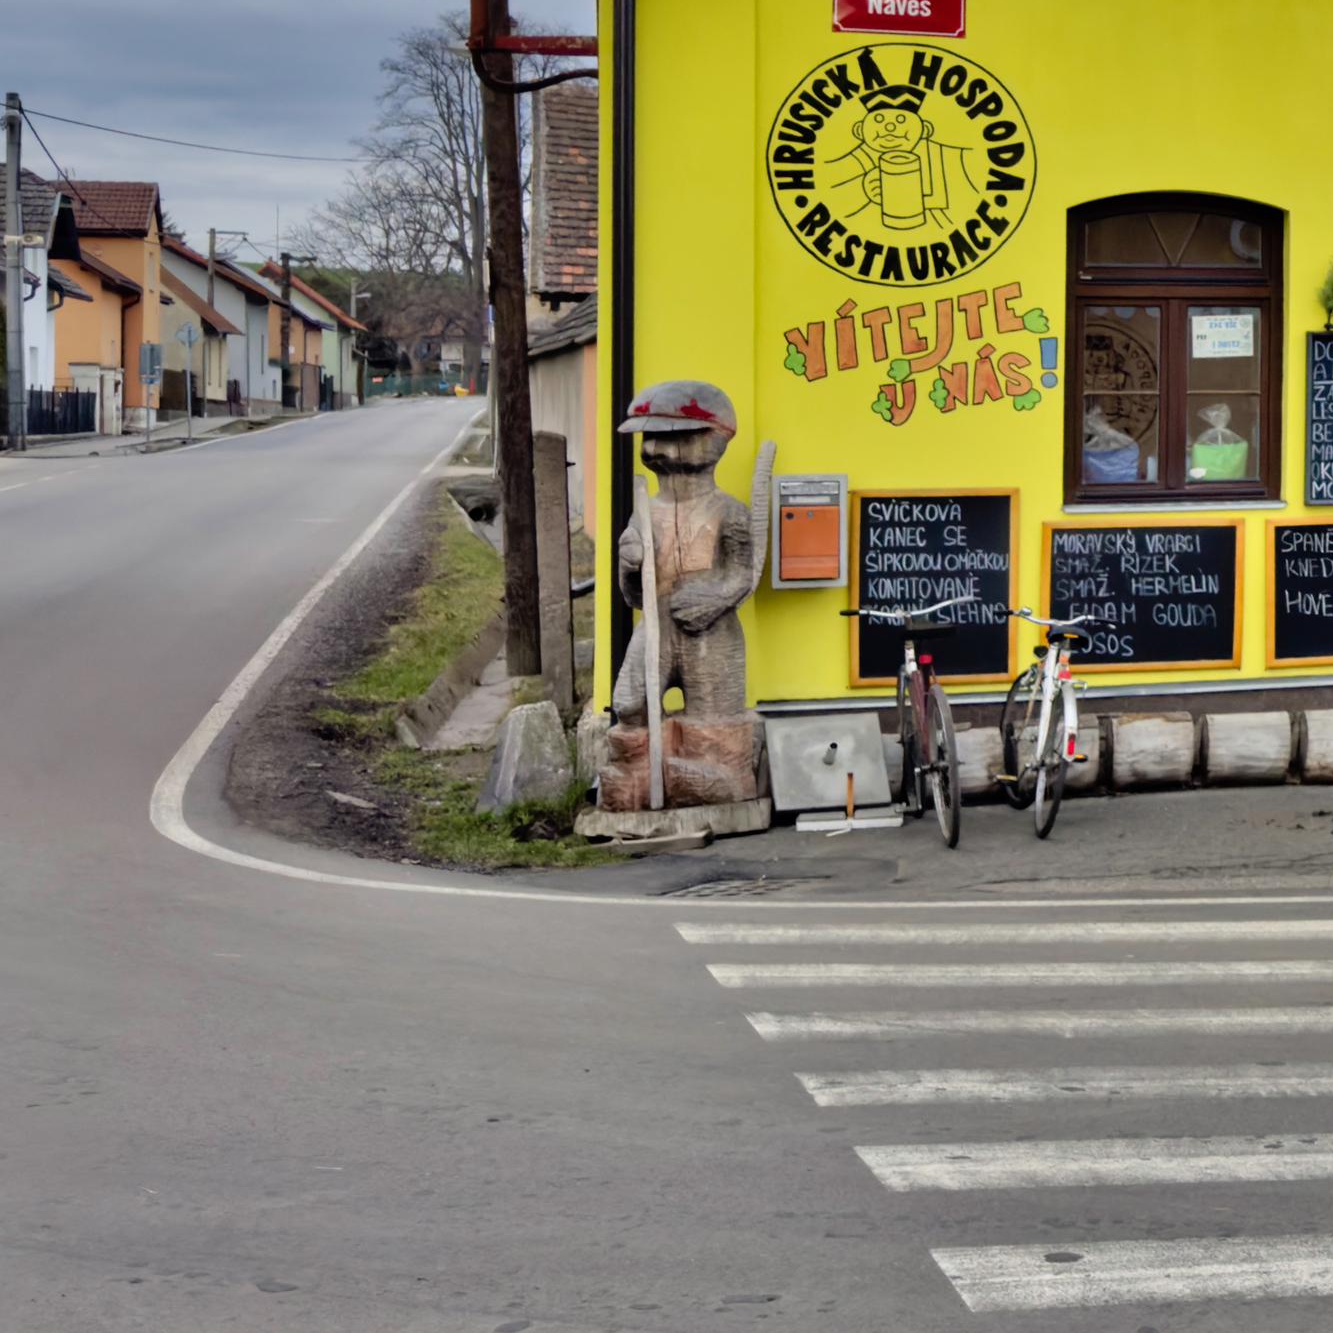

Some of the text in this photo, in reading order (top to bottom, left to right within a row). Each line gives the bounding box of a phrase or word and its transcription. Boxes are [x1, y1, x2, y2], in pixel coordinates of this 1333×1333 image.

[773, 47, 1026, 192] HRUSICKÁ HOSPODA
[796, 199, 1010, 281] RESTAURACE
[784, 282, 1027, 382] VÍTEJTE
[1313, 363, 1327, 379] A
[879, 379, 917, 426] U
[869, 526, 968, 547] KANEC SE
[1153, 603, 1217, 627] GOUDA
[1070, 632, 1134, 657] OSOS
